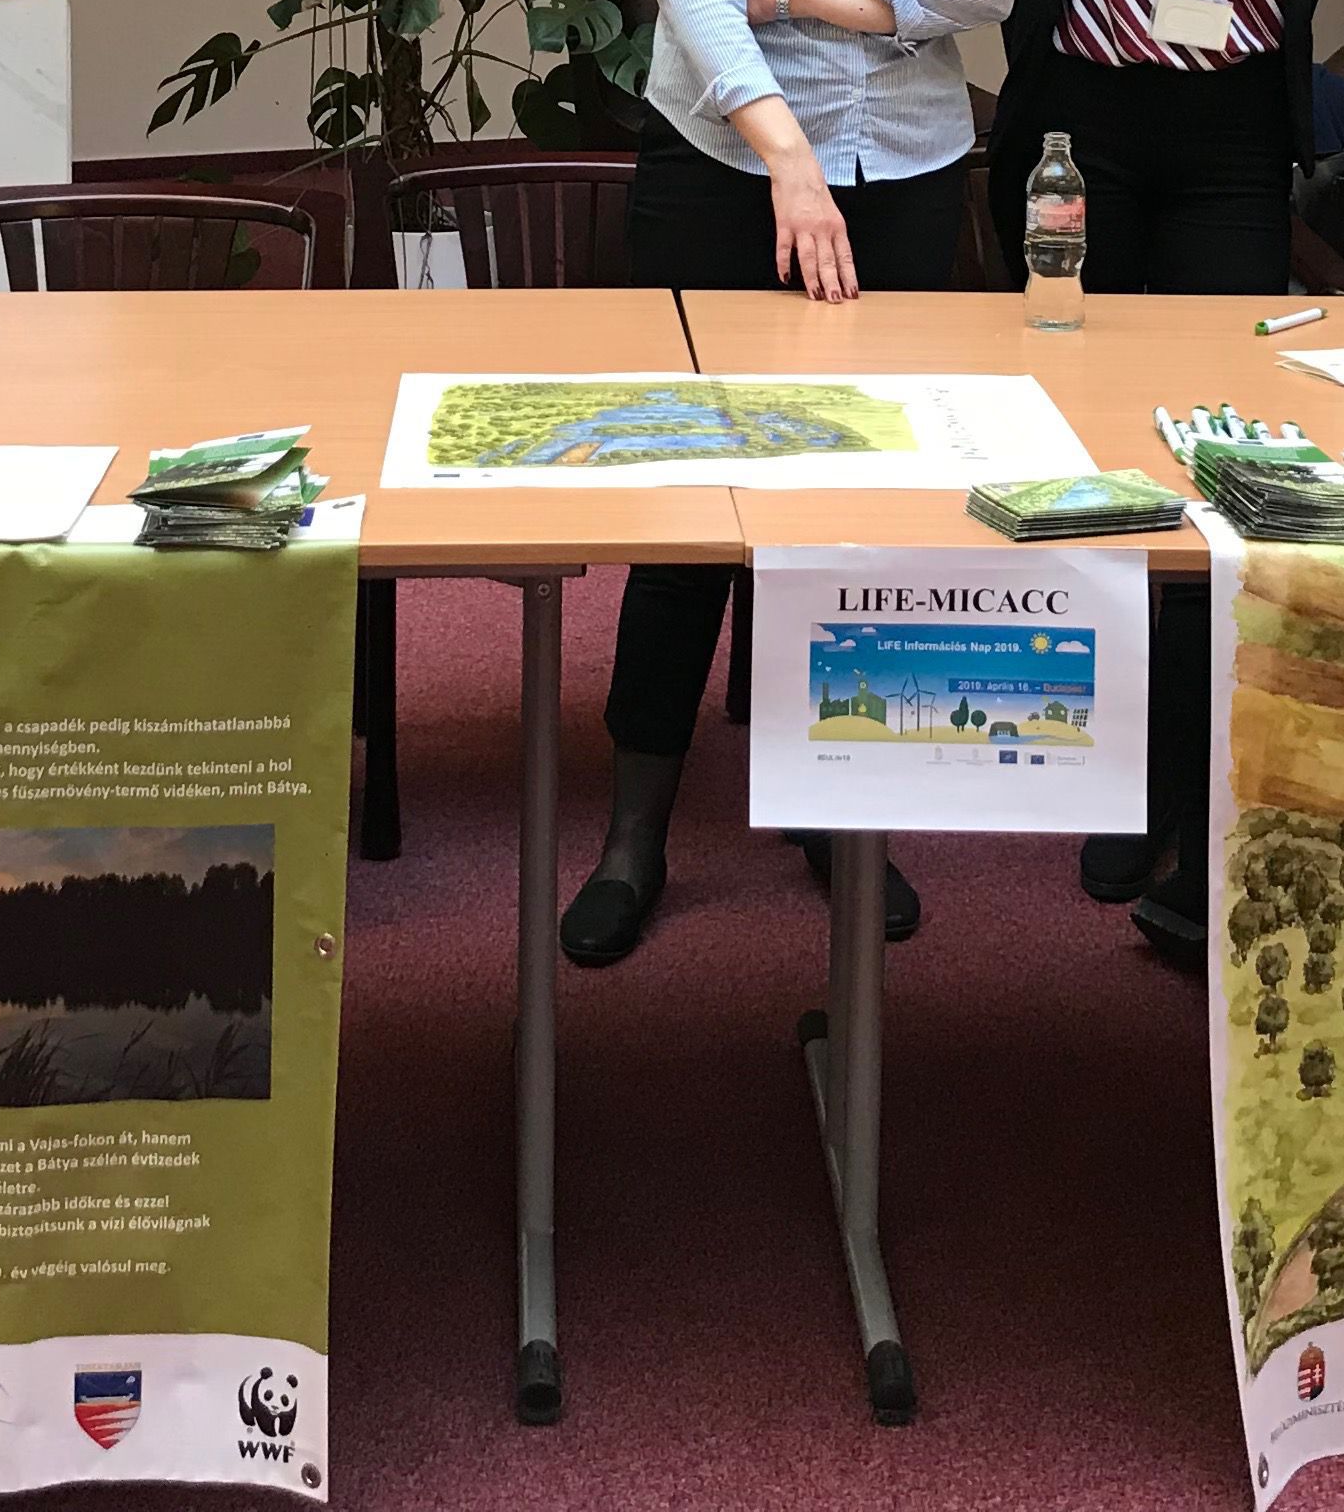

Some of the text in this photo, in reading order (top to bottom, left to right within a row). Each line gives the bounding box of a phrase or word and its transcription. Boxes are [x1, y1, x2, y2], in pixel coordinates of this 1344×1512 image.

[838, 587, 1069, 614] LIFE-MICACC
[878, 640, 901, 651] LIFE
[905, 641, 966, 651] Információs
[971, 642, 991, 654] Nap
[5, 722, 12, 733] a
[17, 718, 85, 734] csapadék
[90, 718, 130, 735] pedig
[134, 716, 290, 733] kiszámíthatatlanabbá
[9, 763, 44, 781] hogy
[49, 761, 119, 776] értékként
[124, 762, 182, 776] kezdünk
[188, 761, 252, 775] tekinteni
[257, 762, 264, 772] a
[269, 758, 291, 772] hol
[13, 784, 159, 799] fűszernövény-termő
[164, 784, 224, 798] vidéken,
[229, 782, 263, 796] mint
[268, 780, 311, 796] Bátya.
[238, 1441, 295, 1463] WWF
